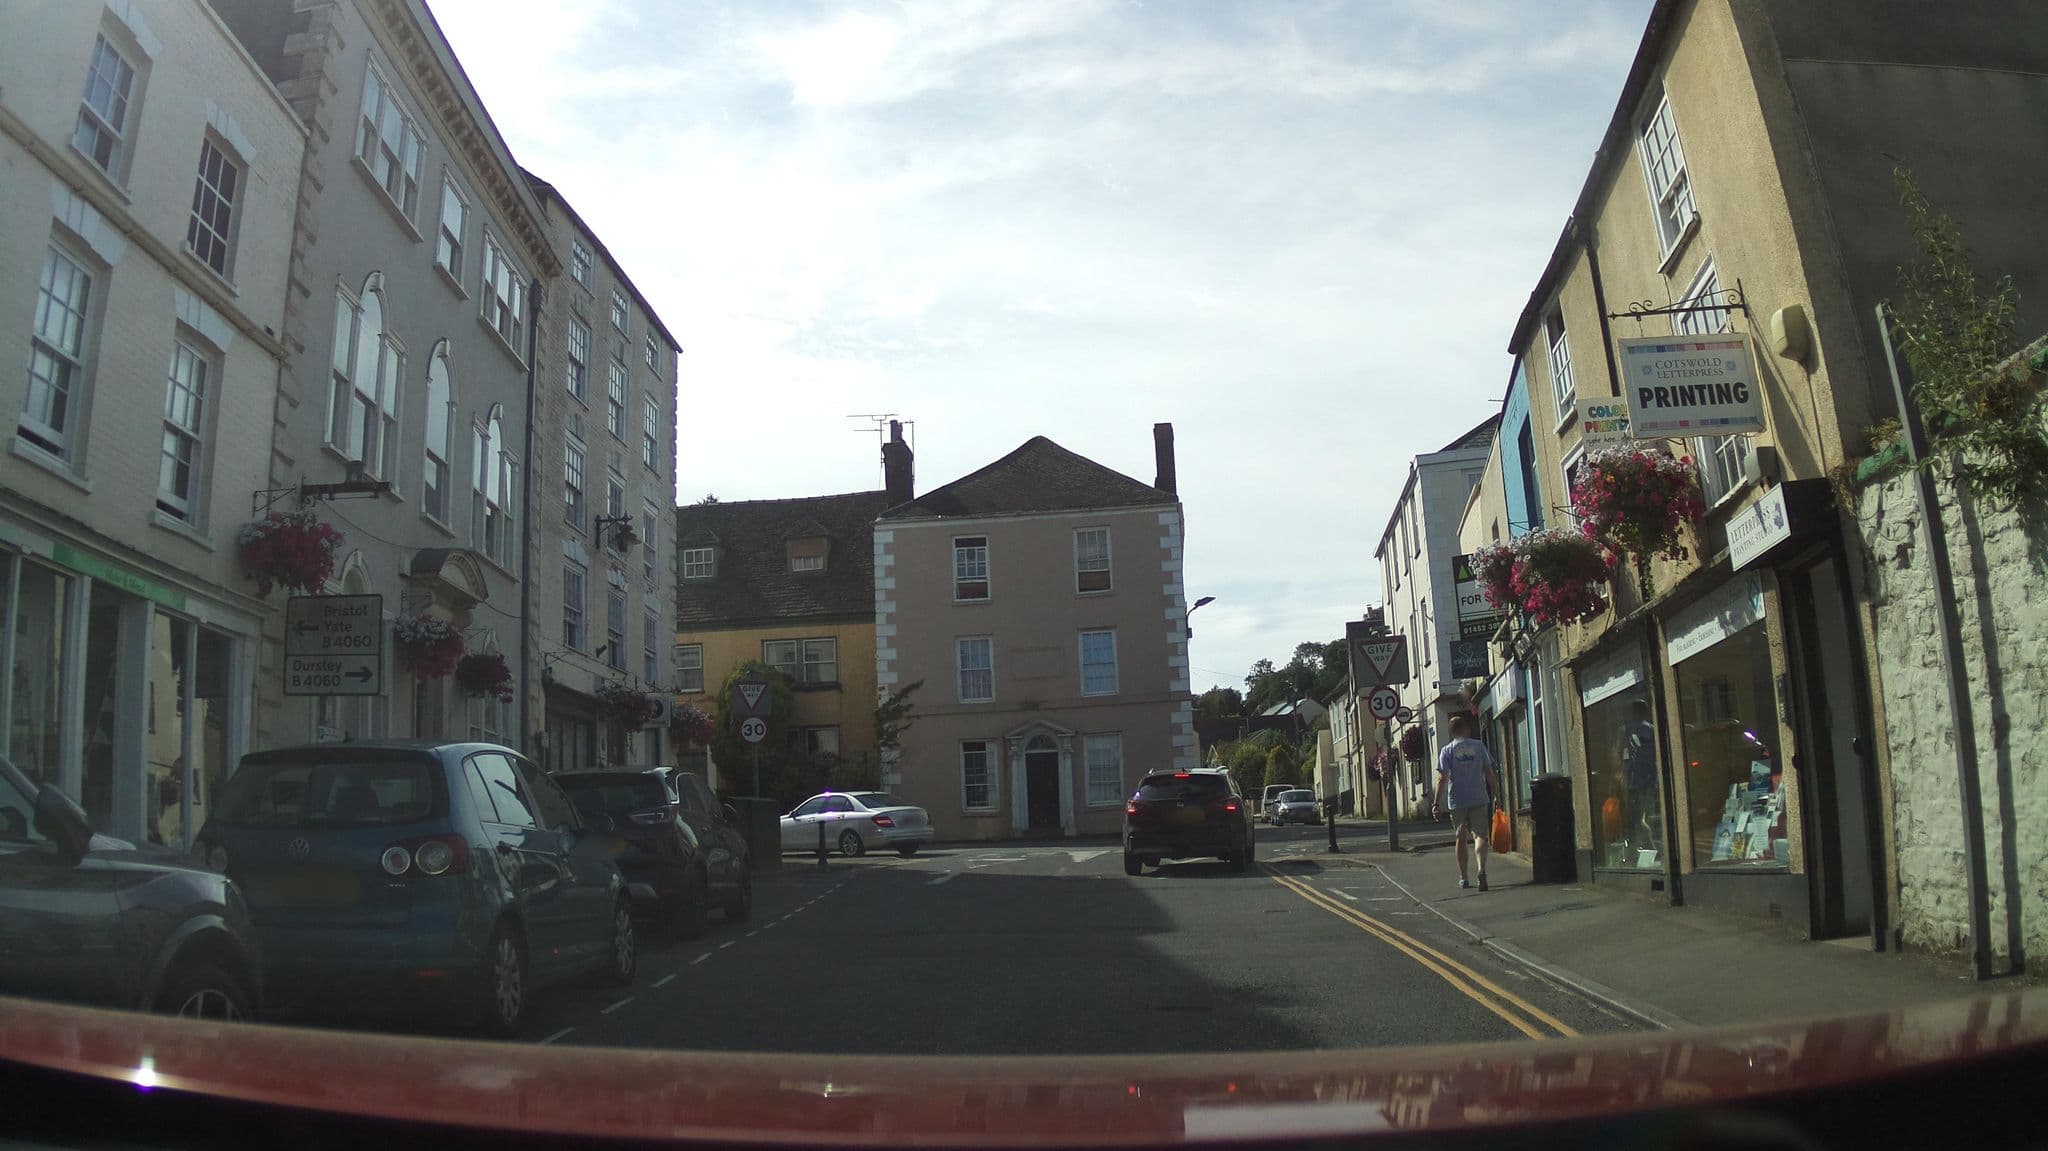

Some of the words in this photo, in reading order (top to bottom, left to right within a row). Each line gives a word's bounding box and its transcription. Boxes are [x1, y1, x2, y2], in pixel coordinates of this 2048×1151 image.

[1655, 357, 1722, 370] COTSWOLD
[1657, 367, 1724, 379] LETTERPRESS
[1638, 382, 1749, 409] PRINTING
[1461, 594, 1482, 607] FOR
[324, 604, 367, 617] Bristol
[326, 621, 353, 632] Yate
[1463, 623, 1486, 634] 01452
[1367, 644, 1393, 655] GIVE
[293, 660, 343, 673] Dursley
[1373, 695, 1396, 711] 30
[743, 723, 765, 737] 30
